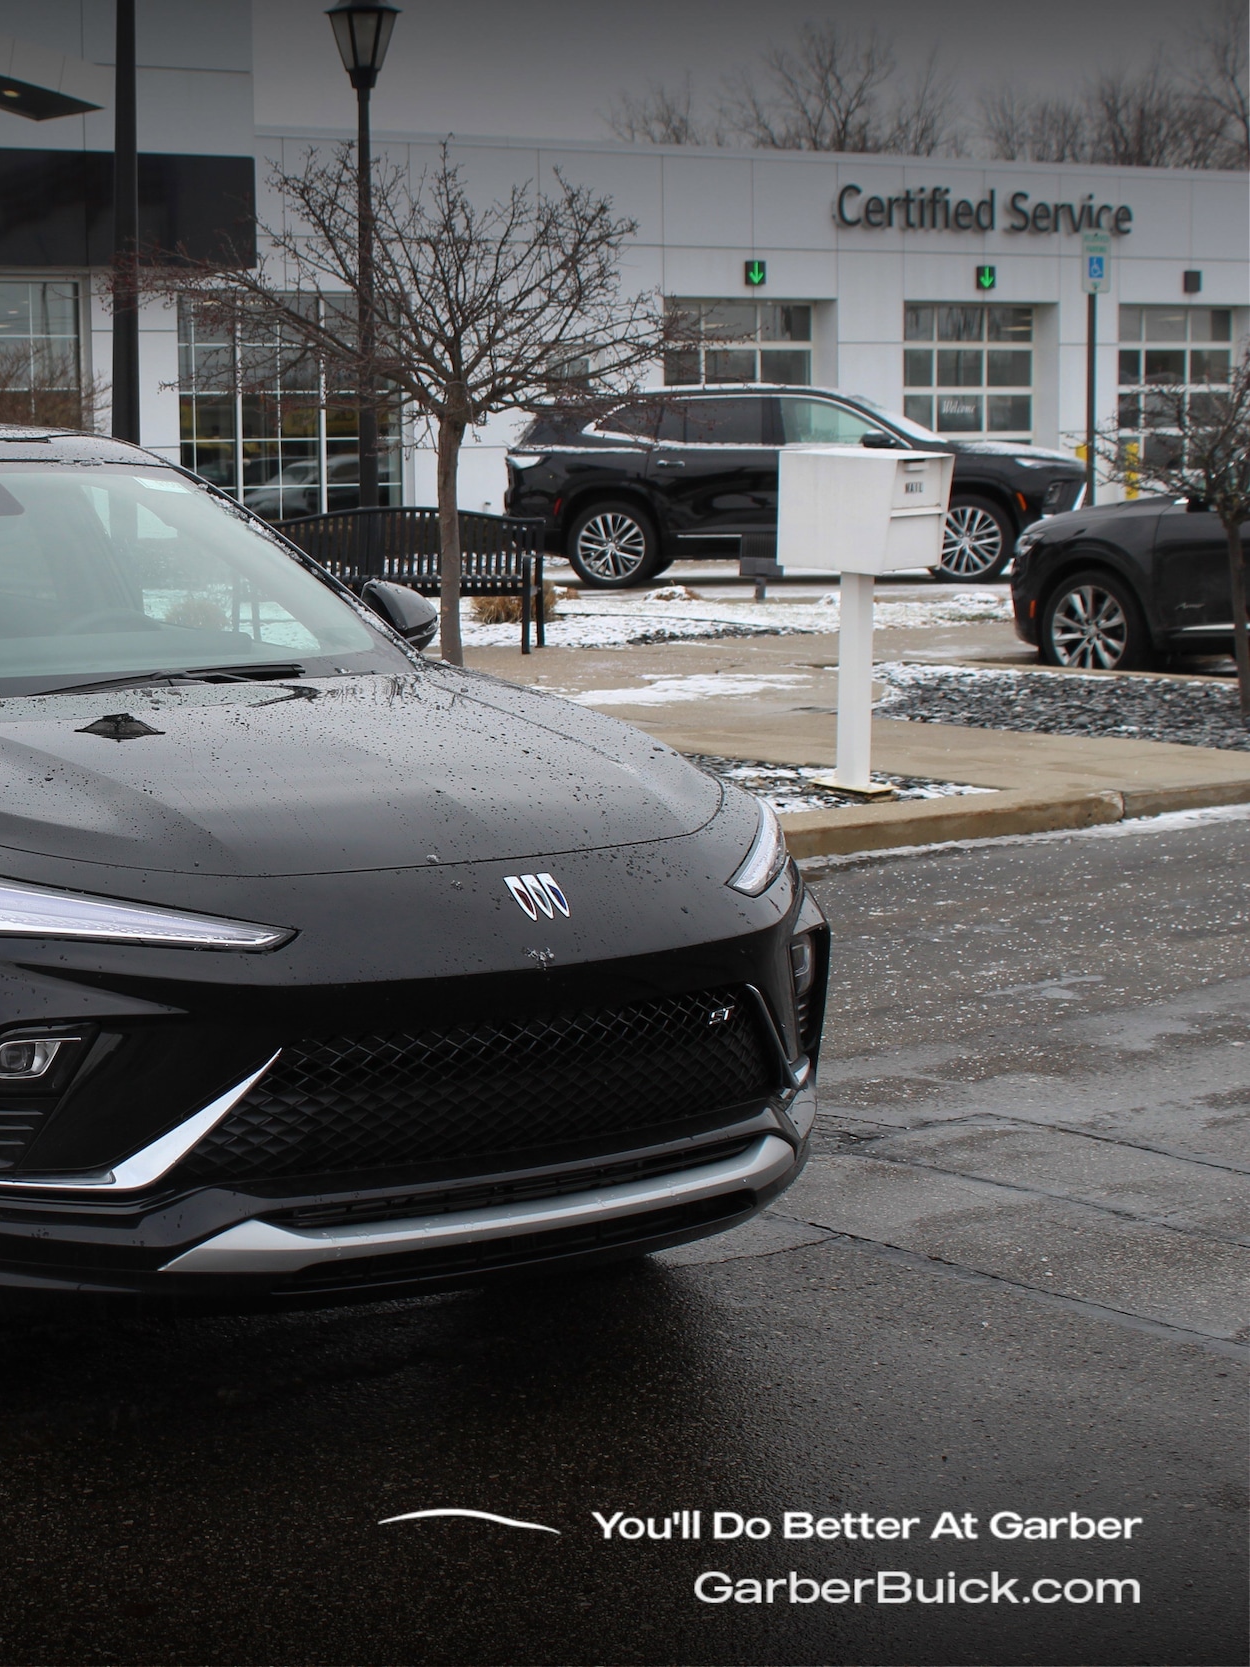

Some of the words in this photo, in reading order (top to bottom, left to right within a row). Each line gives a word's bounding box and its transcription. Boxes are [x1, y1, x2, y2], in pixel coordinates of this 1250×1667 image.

[838, 184, 995, 231] Certified
[1010, 192, 1133, 234] Service
[905, 482, 923, 494] MAIL
